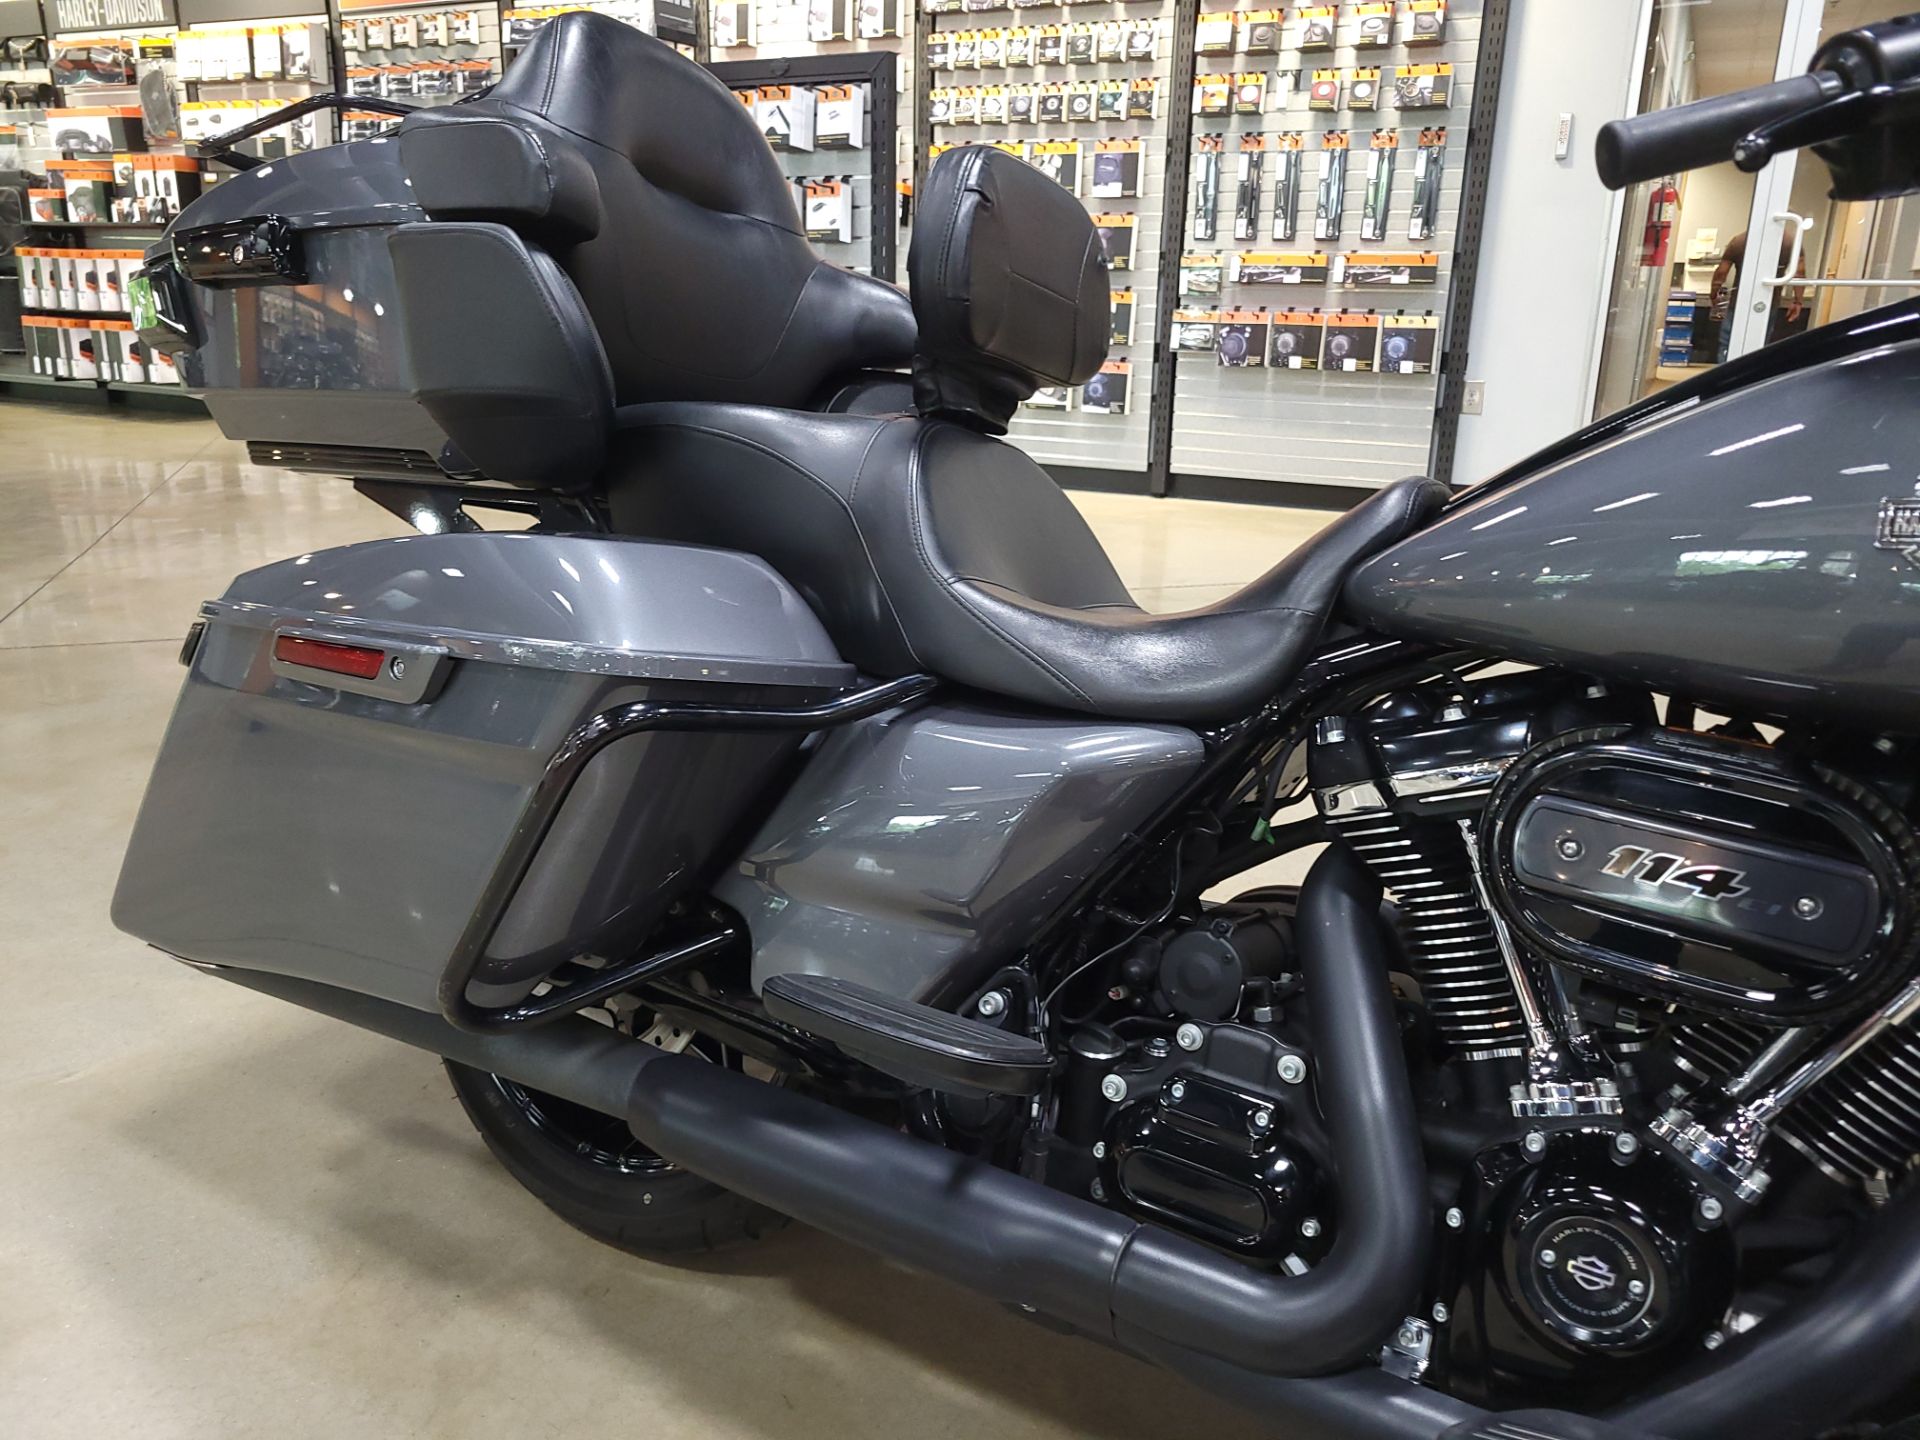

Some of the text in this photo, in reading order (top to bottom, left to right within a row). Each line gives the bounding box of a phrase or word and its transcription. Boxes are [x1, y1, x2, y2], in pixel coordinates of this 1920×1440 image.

[57, 0, 164, 28] HARLEY-DAVIDSON
[1600, 844, 1751, 901] 114
[1552, 1227, 1637, 1270] HARLEY-DAVIDSON
